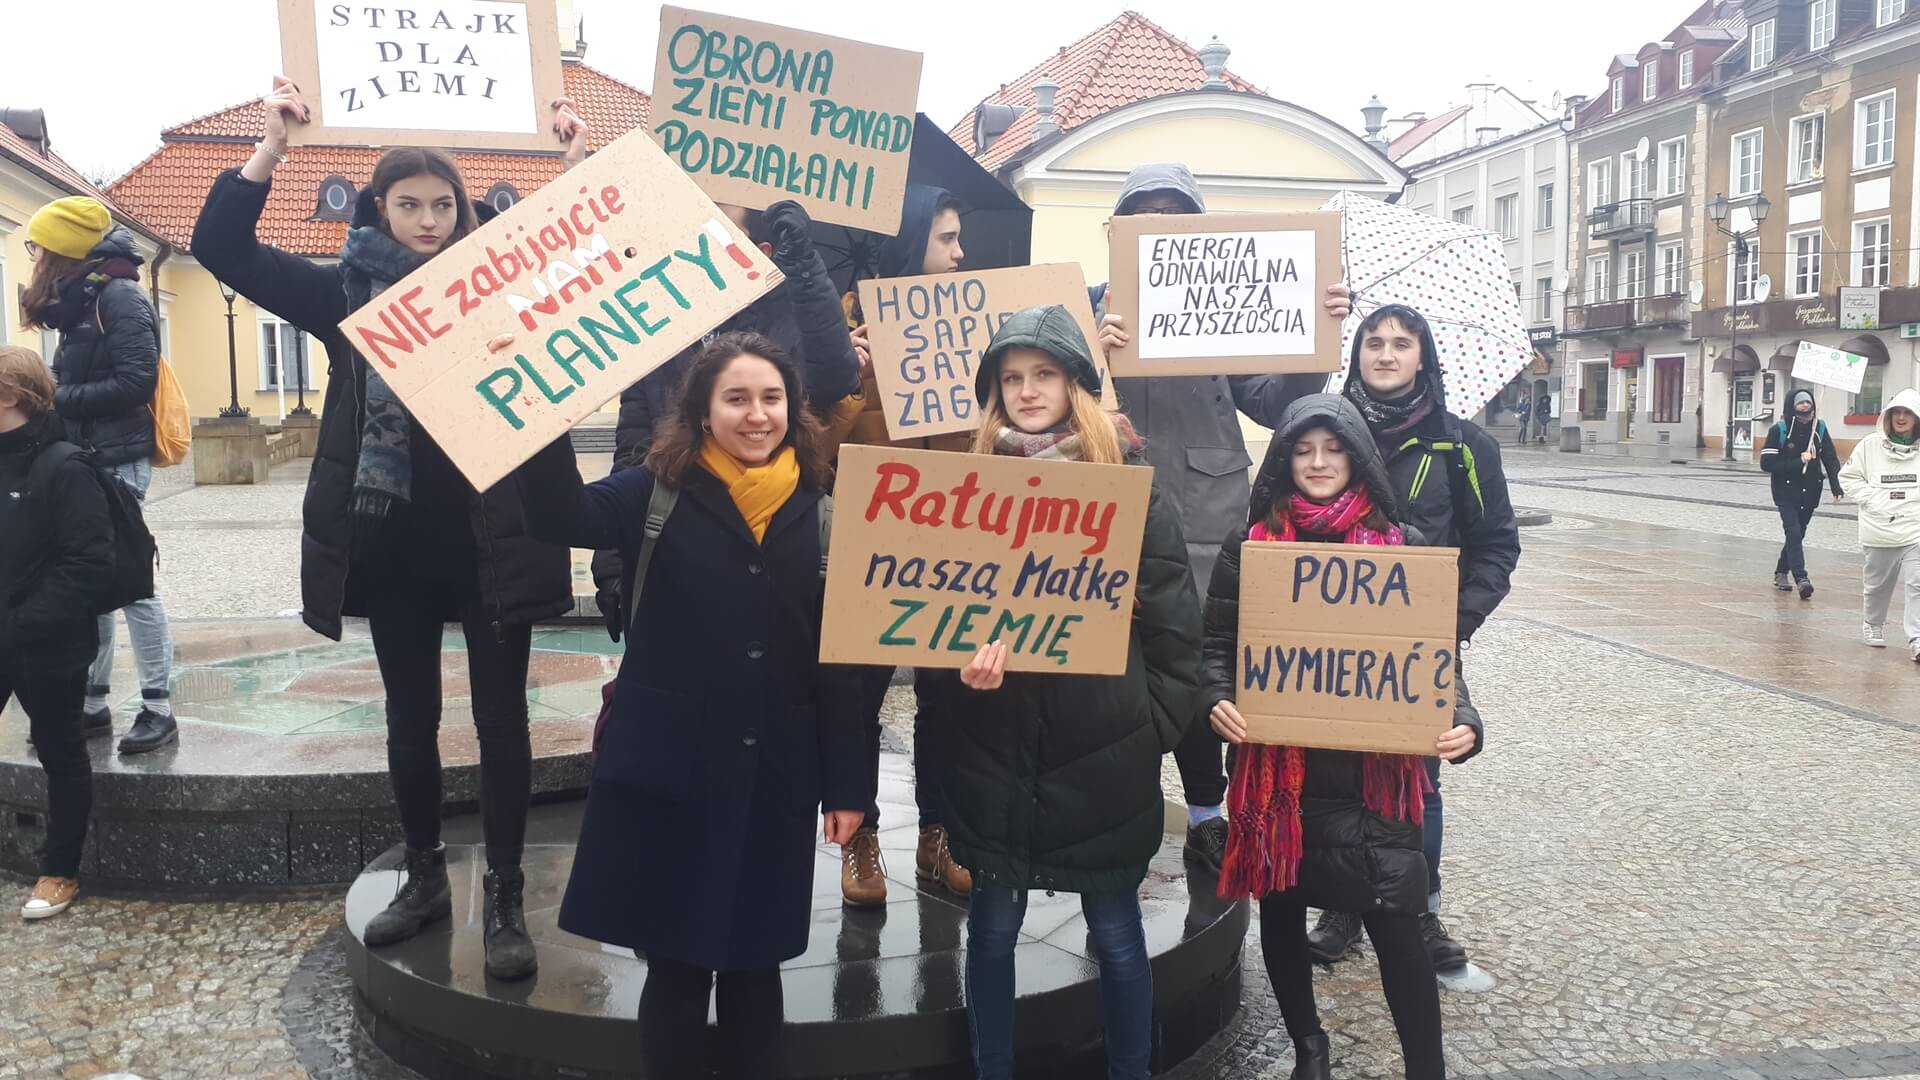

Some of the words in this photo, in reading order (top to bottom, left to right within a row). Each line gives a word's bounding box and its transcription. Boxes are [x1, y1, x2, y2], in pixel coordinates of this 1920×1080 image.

[330, 4, 519, 35] STRAJK
[375, 41, 480, 66] DLA
[668, 24, 834, 96] OBRONA
[340, 70, 498, 112] ZIEMI
[672, 77, 787, 130] ZIEMI
[810, 98, 913, 153] PONAD
[654, 119, 874, 210] PODZIAŁAMI
[355, 285, 453, 370] NIE
[445, 184, 626, 317] zabijajcie
[1149, 258, 1299, 288] ODNAWIALNA
[1152, 237, 1257, 262] ENERGIA
[876, 278, 986, 323] HOMO
[865, 462, 1117, 556] Ratujmy
[865, 552, 1001, 599] naszą
[1012, 550, 1130, 610] Matkę
[1292, 555, 1411, 607] PORA
[878, 599, 1084, 665] ZIEMIĘ
